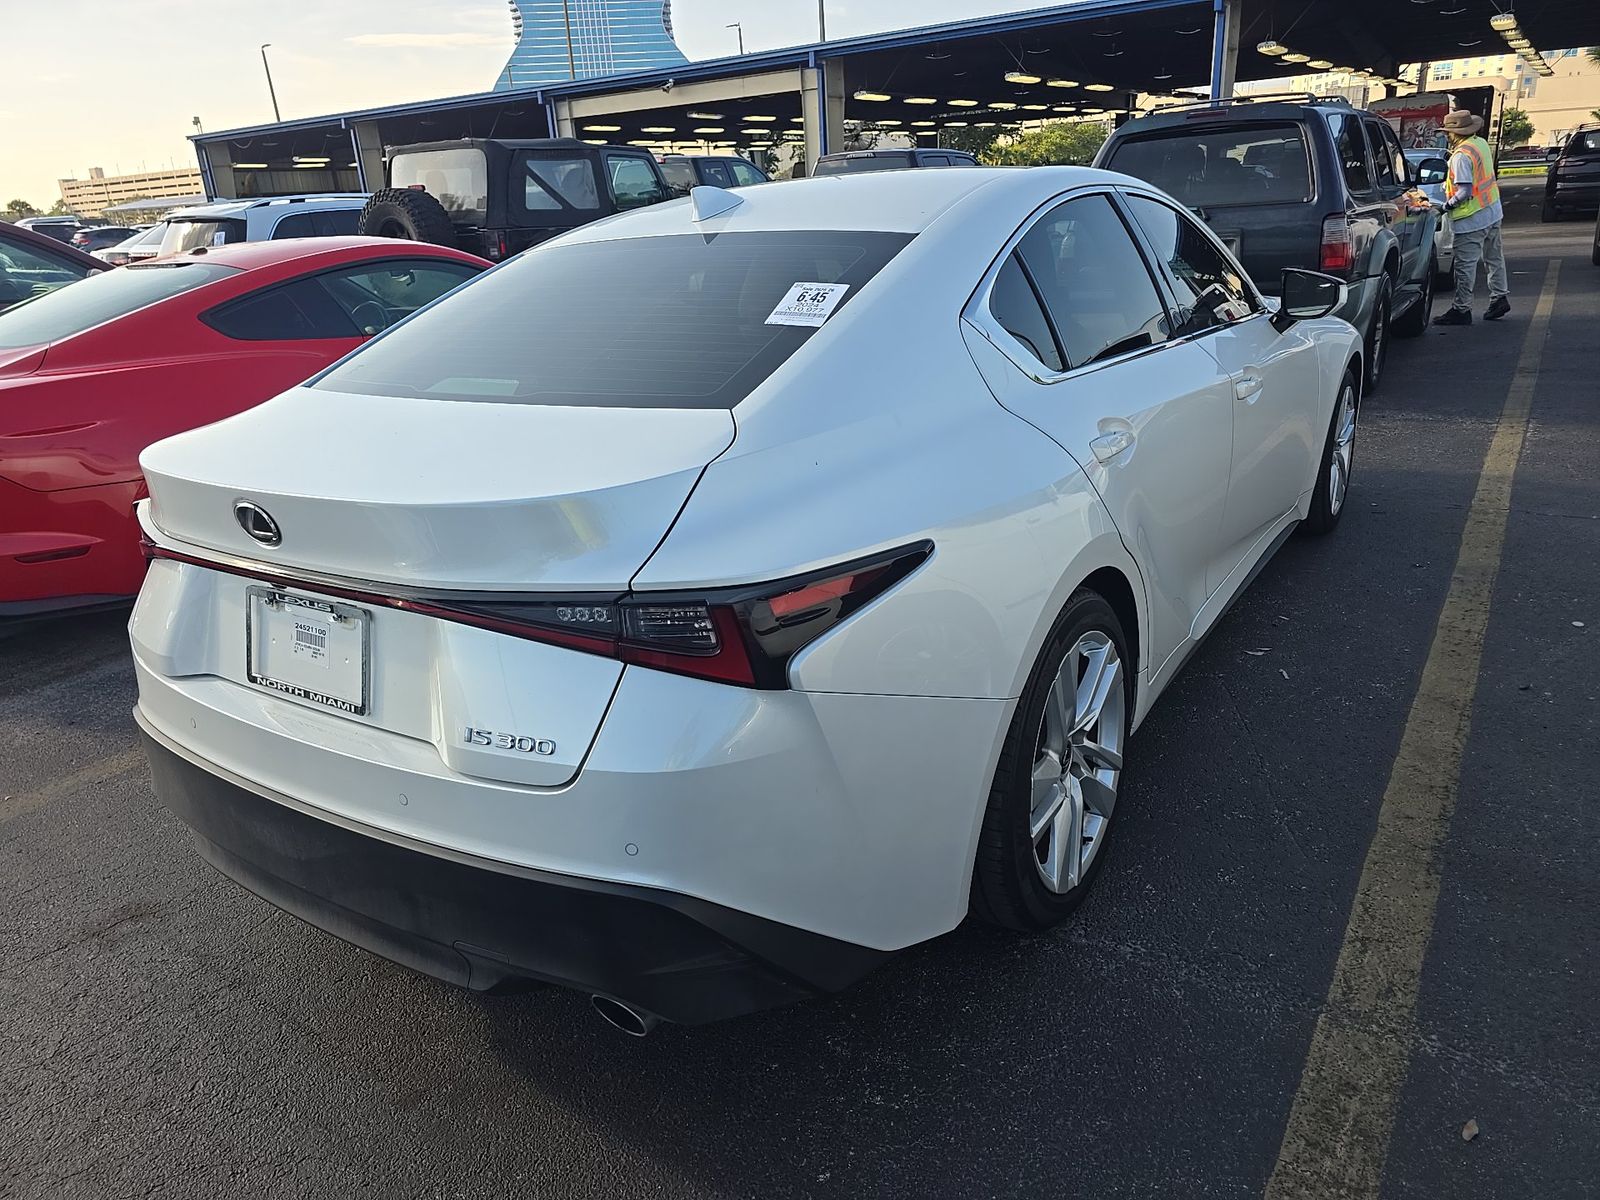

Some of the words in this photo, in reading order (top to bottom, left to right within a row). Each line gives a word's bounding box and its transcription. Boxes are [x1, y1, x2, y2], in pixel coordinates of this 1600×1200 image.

[797, 291, 829, 303] 6:45
[275, 593, 332, 612] LEXUS
[295, 622, 327, 636] 24521100
[257, 677, 305, 697] NORTH
[309, 692, 356, 713] MIAMI
[464, 726, 493, 746] IS
[495, 732, 557, 756] 300
